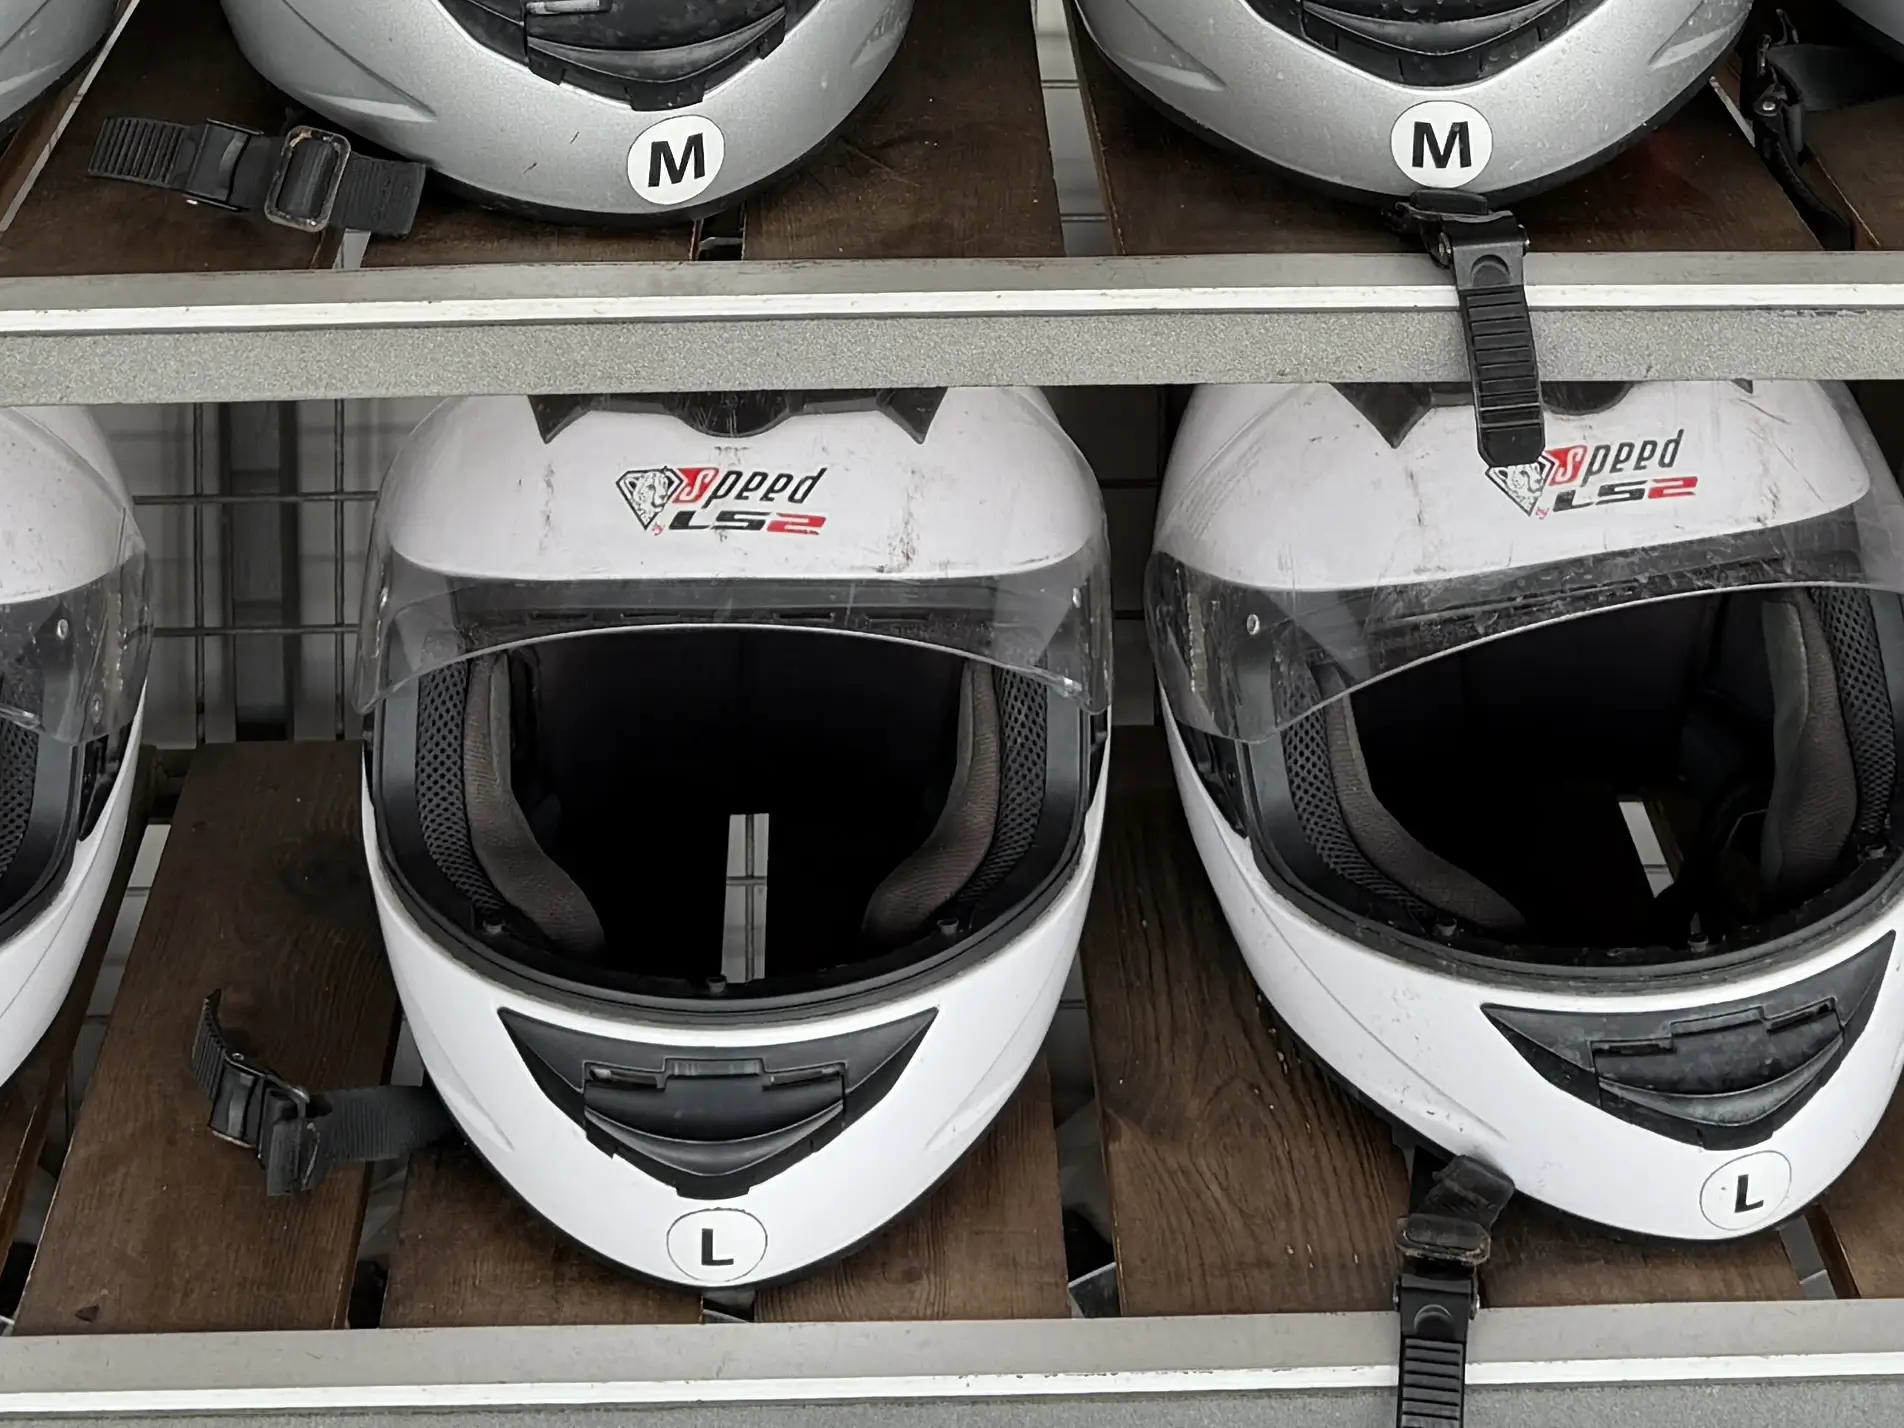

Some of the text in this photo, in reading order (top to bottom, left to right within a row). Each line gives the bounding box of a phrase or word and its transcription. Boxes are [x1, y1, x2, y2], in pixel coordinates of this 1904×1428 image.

[648, 133, 705, 187] M
[1412, 122, 1471, 168] M
[1550, 428, 1684, 487] Speed
[674, 467, 827, 509] Speed
[1553, 476, 1698, 512] LS2
[669, 510, 827, 535] LS2
[1735, 1175, 1763, 1212] L
[702, 1229, 733, 1265] L
